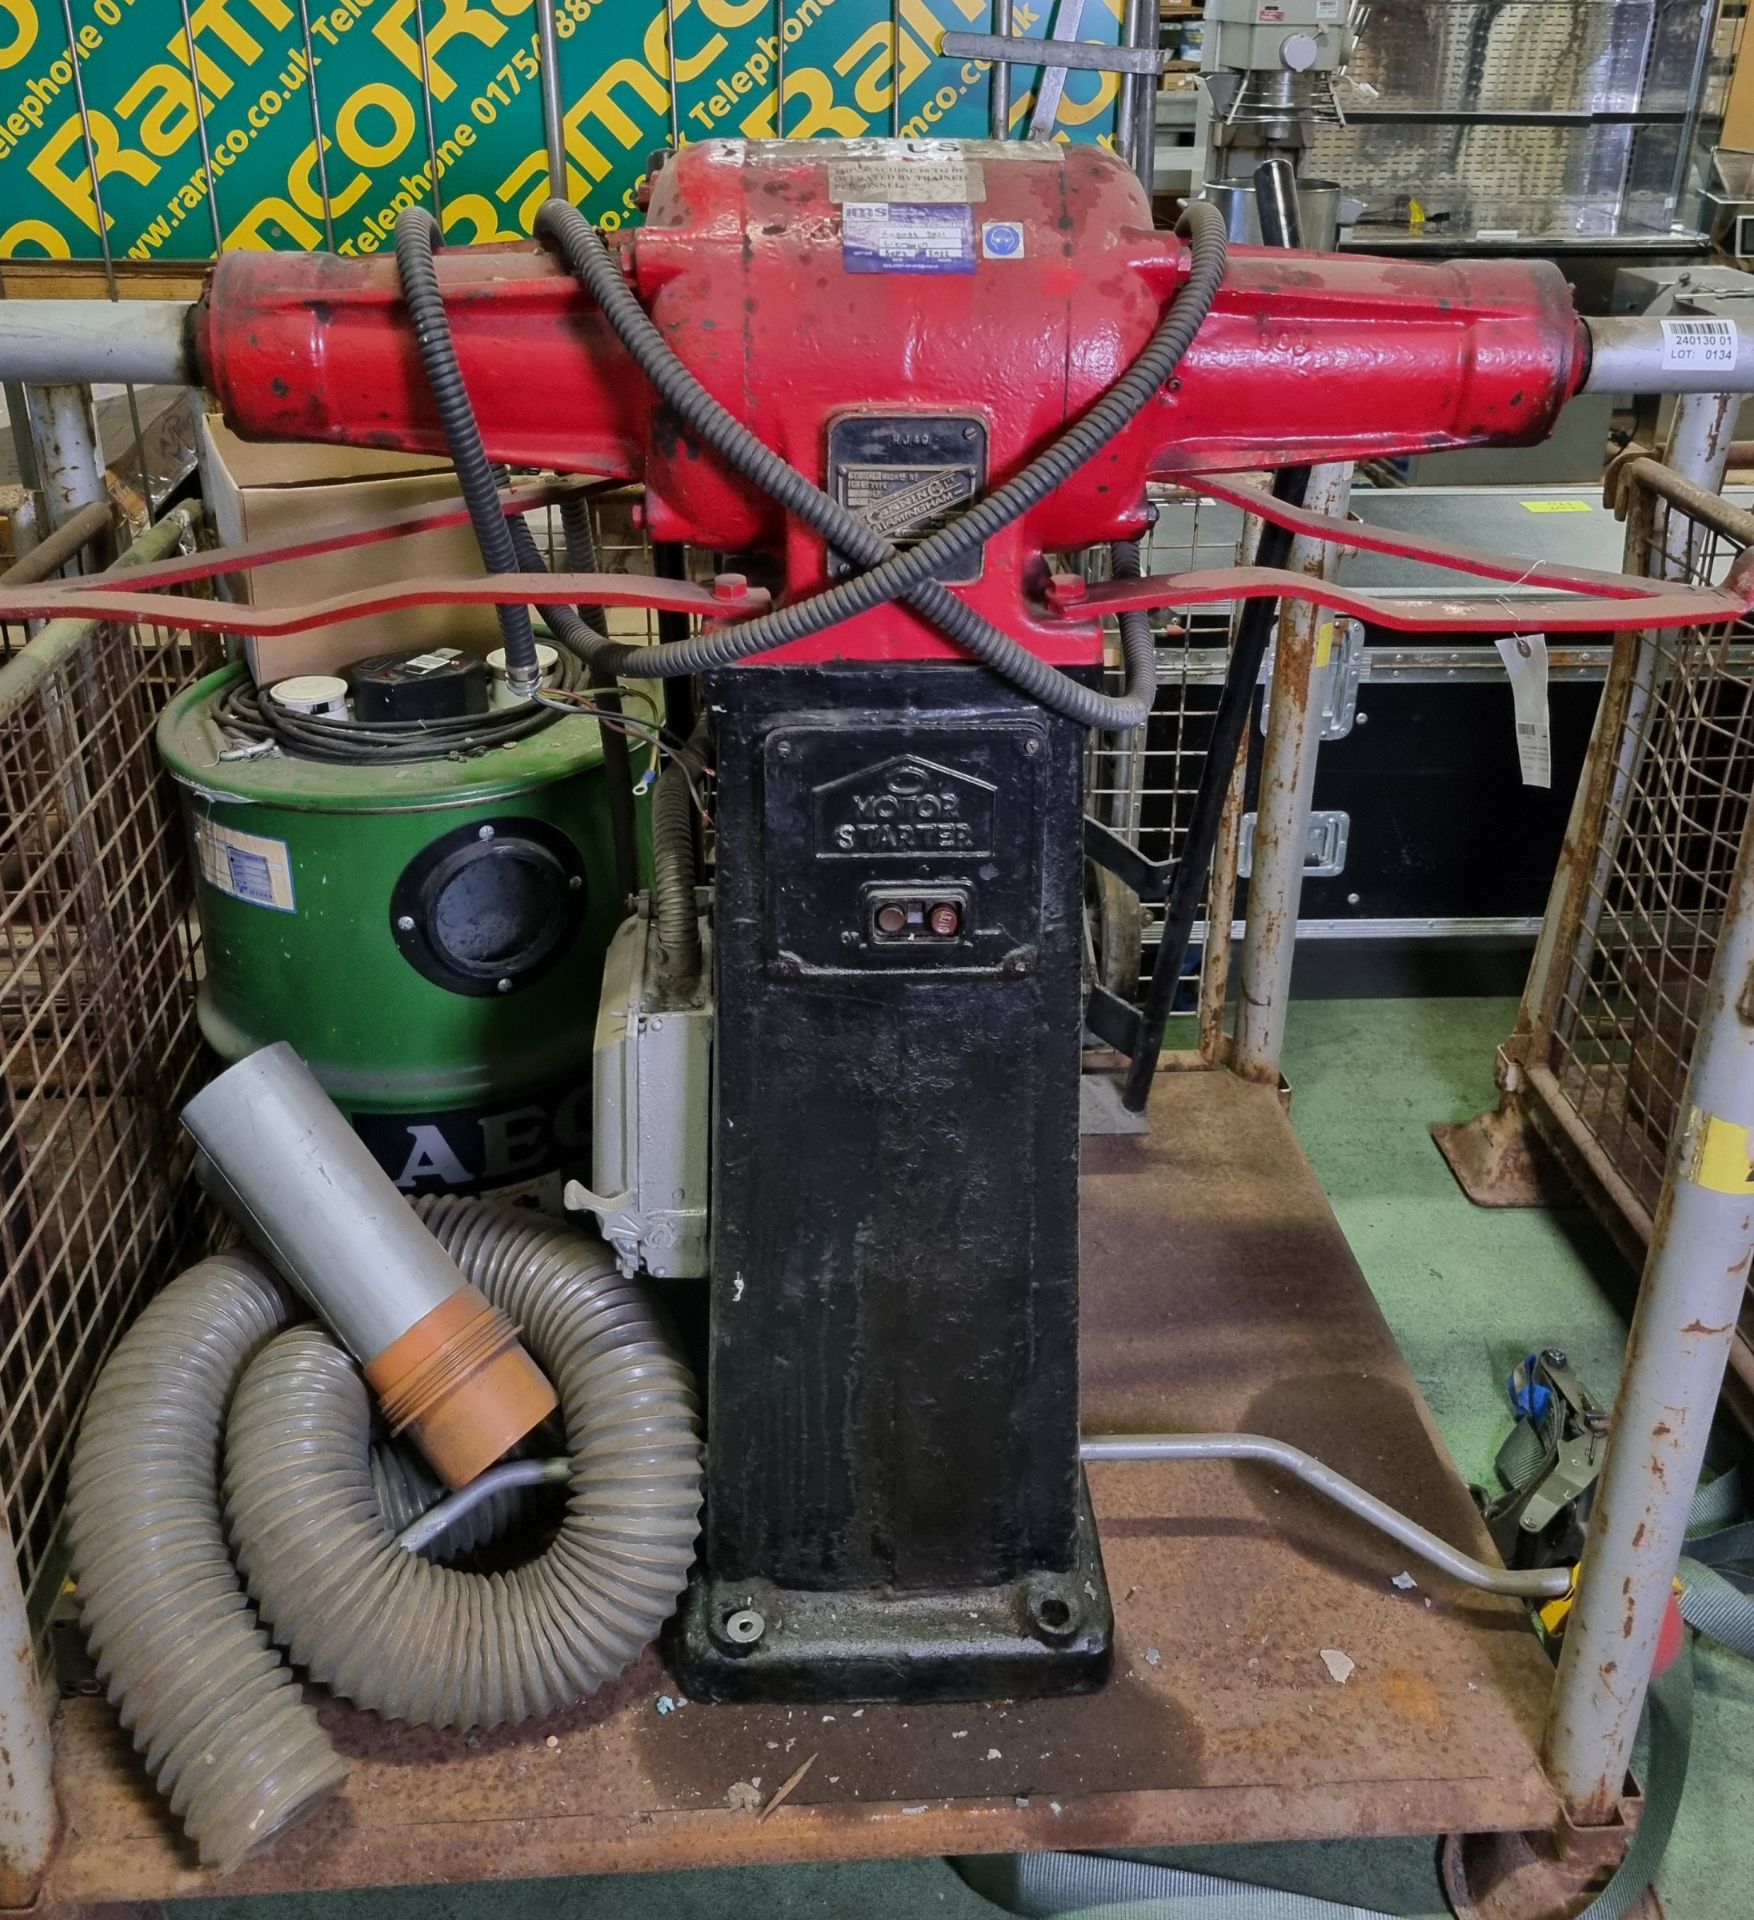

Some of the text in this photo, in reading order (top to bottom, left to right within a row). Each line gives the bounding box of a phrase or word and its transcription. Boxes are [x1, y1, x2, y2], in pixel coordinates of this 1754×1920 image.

[94, 0, 136, 25] 0
[122, 48, 321, 260] ww.ramco.co.uk
[1676, 336, 1716, 346] 240130
[1671, 350, 1732, 360] LOT: 0134
[852, 792, 960, 818] MOTOR
[834, 823, 974, 849] STARTER
